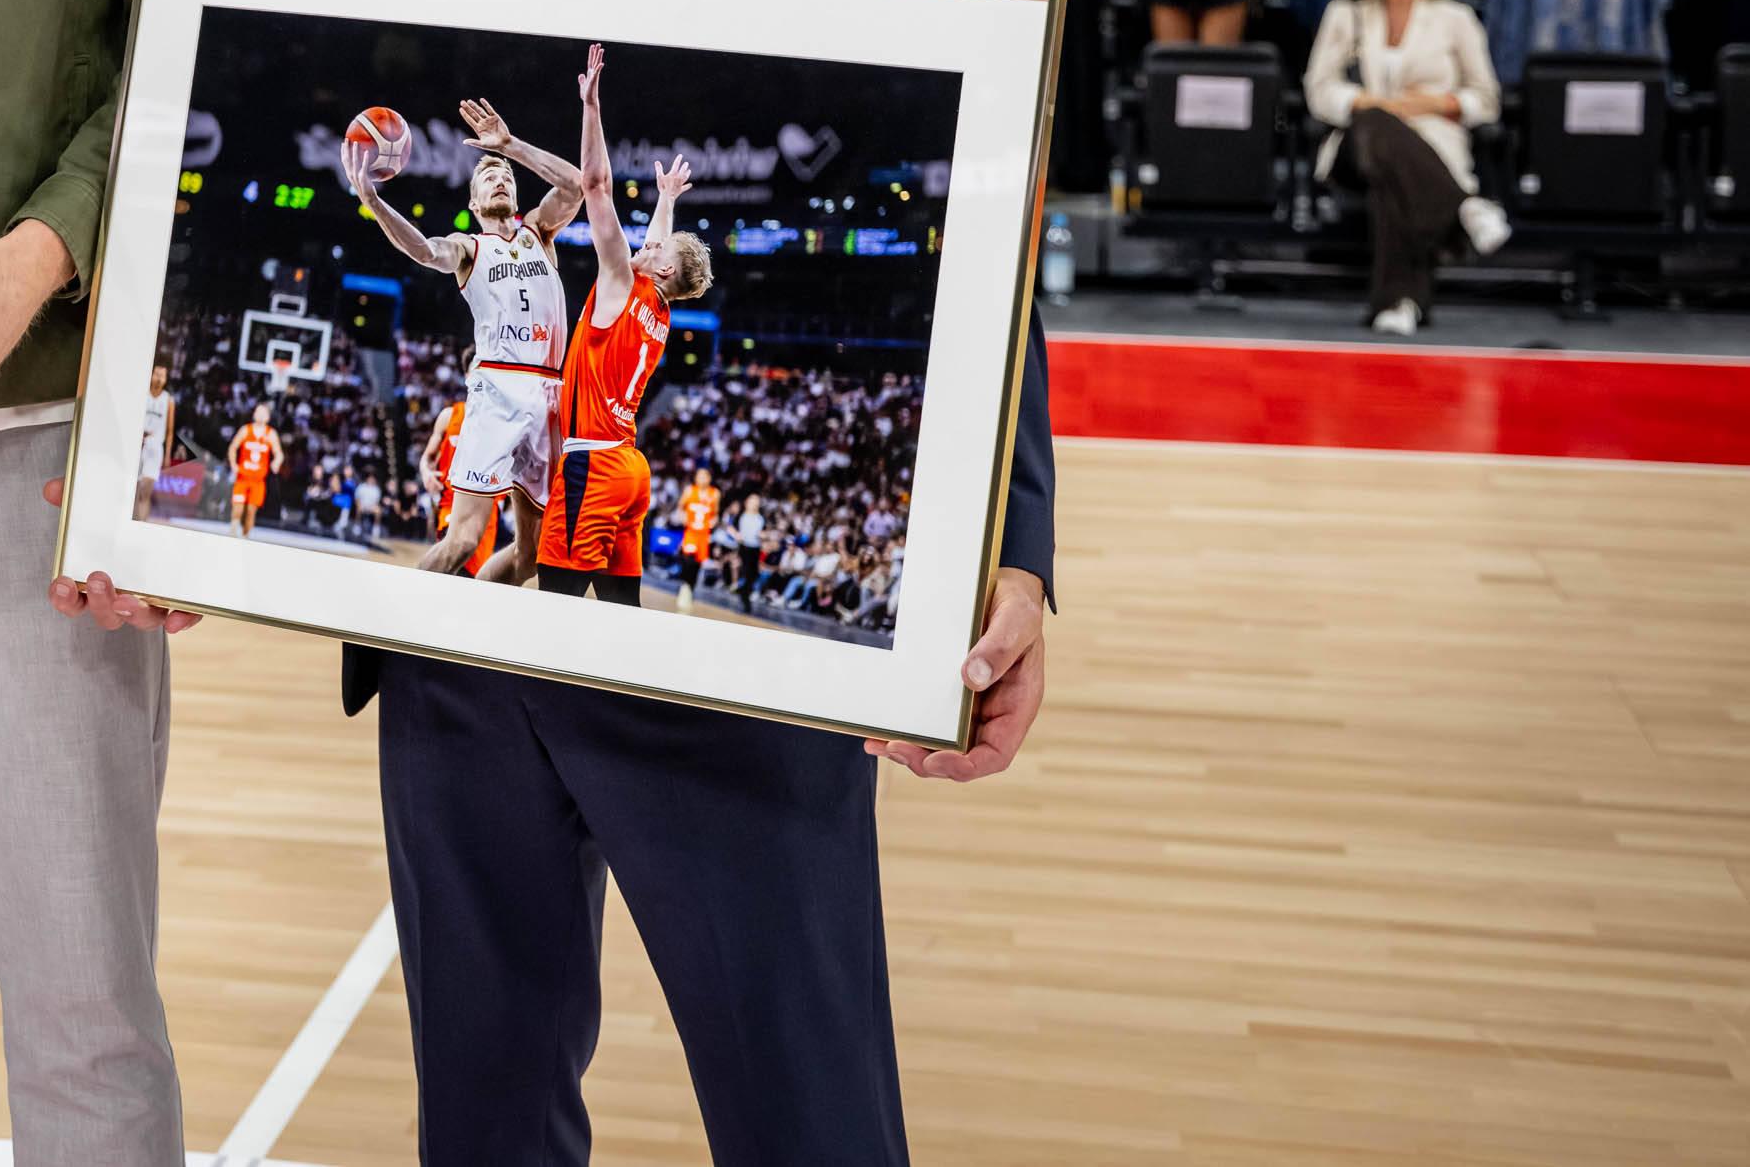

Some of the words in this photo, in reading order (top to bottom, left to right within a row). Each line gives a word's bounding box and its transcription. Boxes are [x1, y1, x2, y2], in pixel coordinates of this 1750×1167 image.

[519, 289, 530, 312] 5
[500, 324, 531, 342] ING
[624, 341, 649, 401] 1
[466, 470, 491, 484] ING
